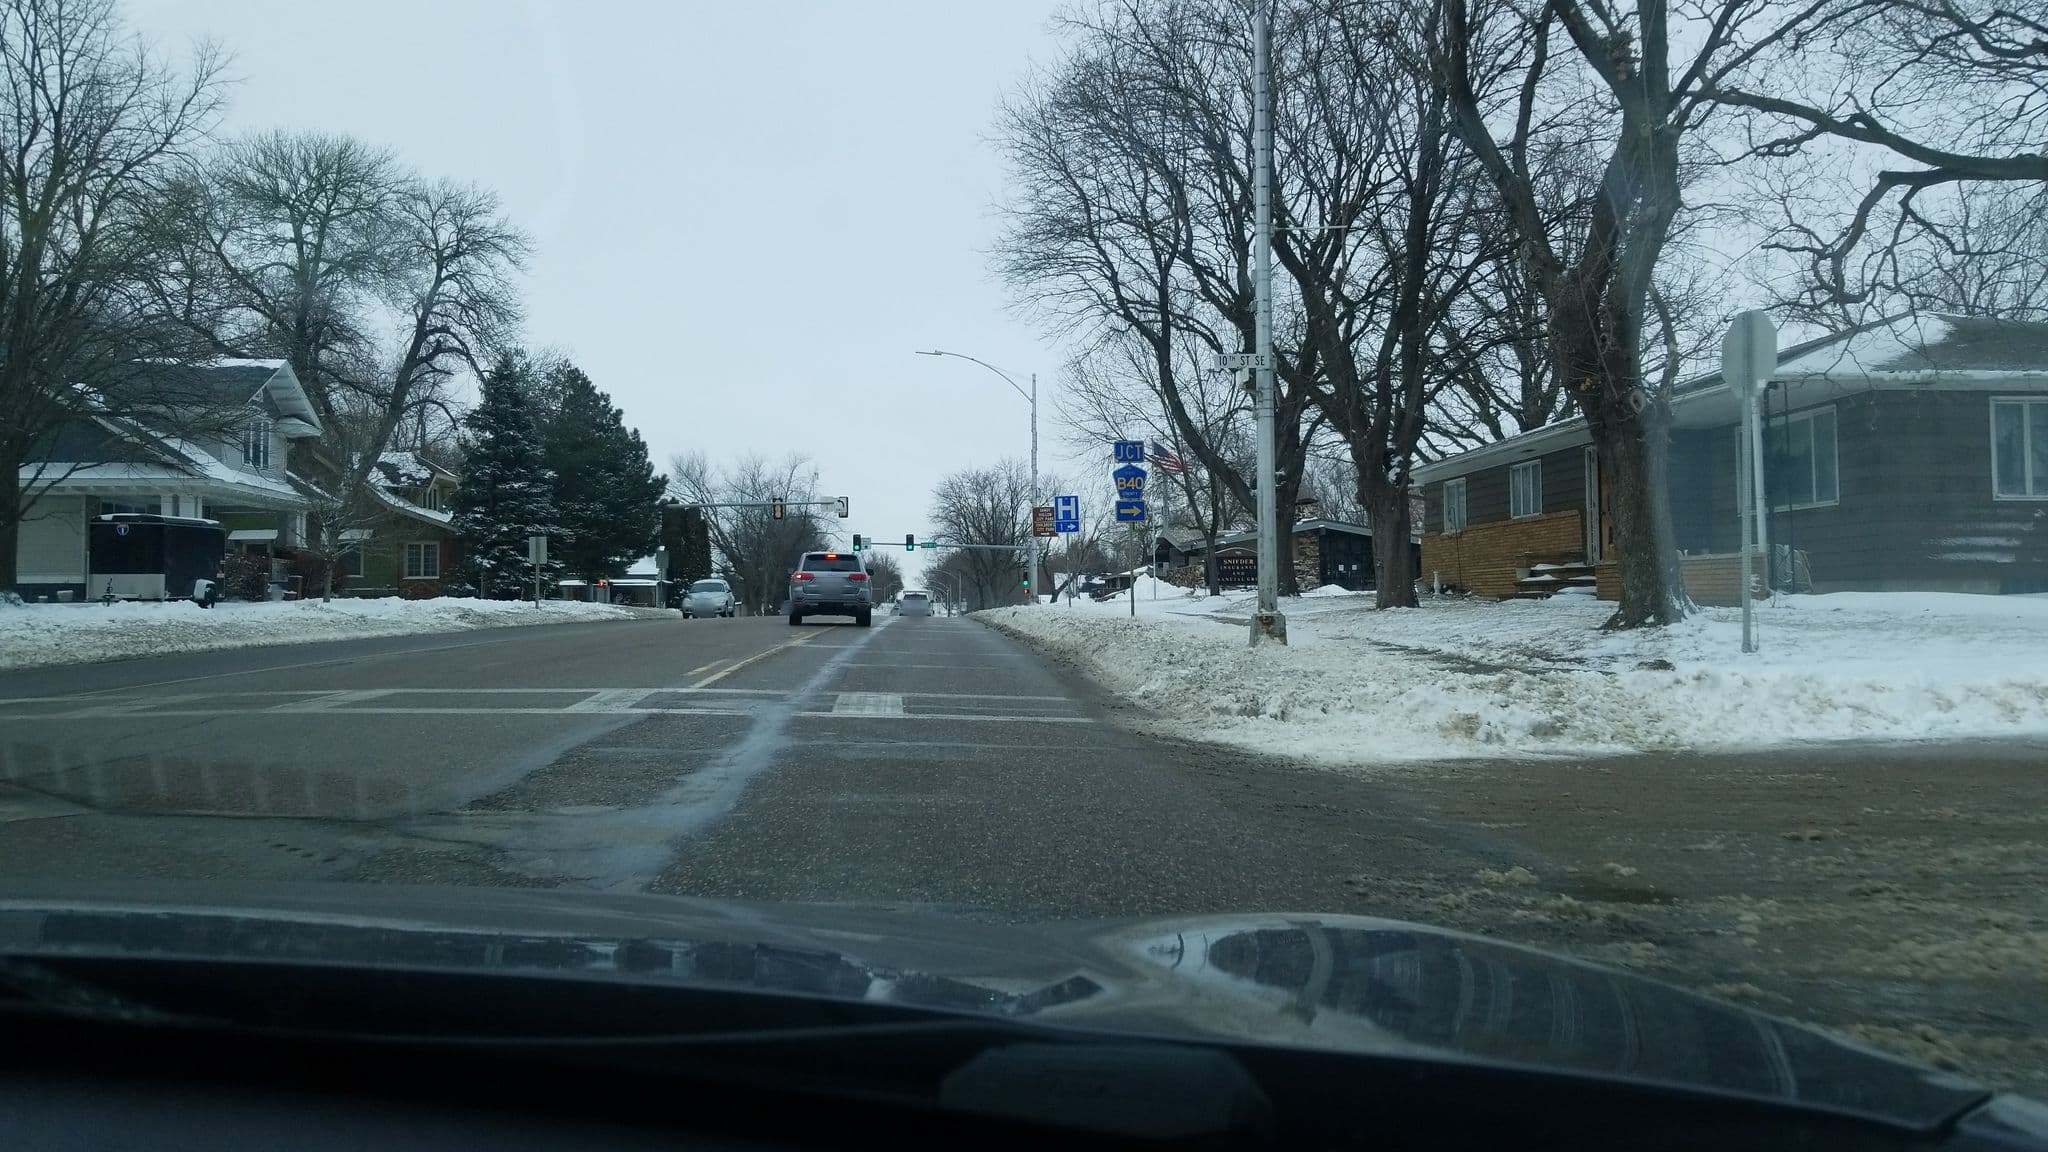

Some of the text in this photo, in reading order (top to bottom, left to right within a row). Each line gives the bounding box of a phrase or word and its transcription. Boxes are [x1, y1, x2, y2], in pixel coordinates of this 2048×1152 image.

[1219, 356, 1264, 366] 10TH ST SE
[1117, 444, 1142, 460] JCT
[1118, 477, 1144, 490] B40
[1058, 498, 1076, 520] H
